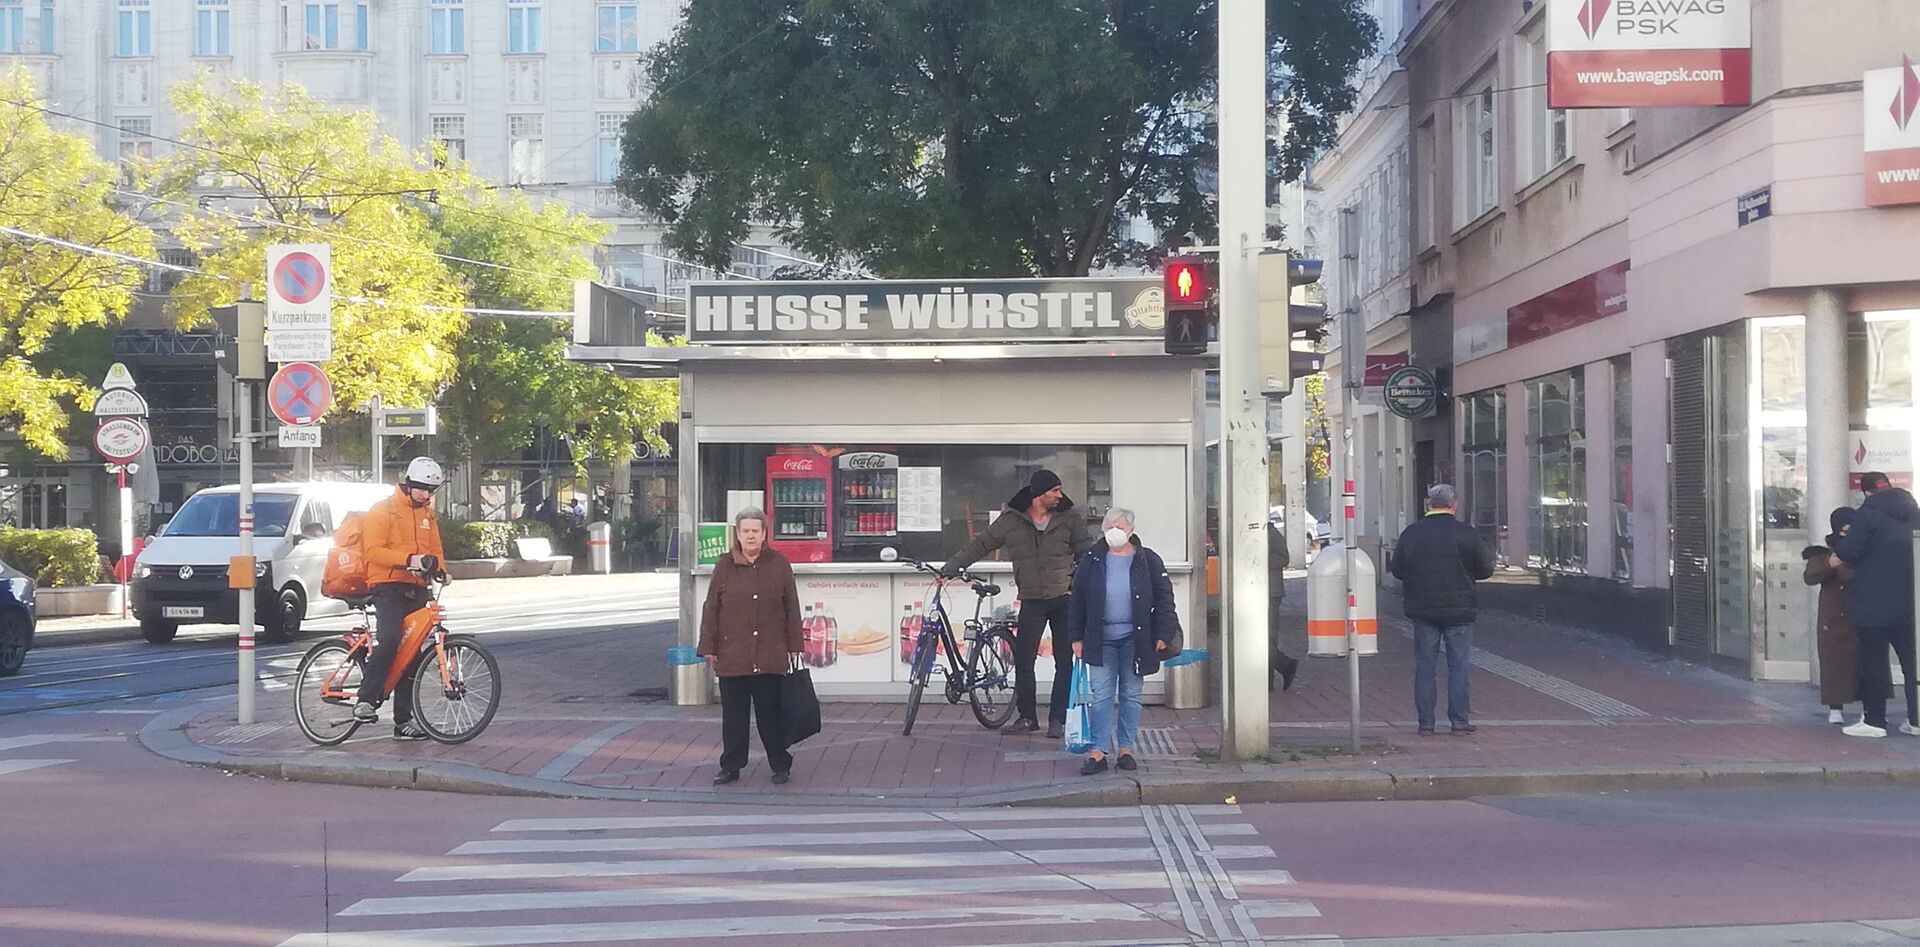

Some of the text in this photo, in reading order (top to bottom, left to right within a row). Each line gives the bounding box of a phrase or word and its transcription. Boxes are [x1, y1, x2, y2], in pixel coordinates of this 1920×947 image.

[1617, 0, 1725, 16] BAWAG
[1617, 19, 1679, 35] PSK
[1577, 67, 1724, 85] www.bawagpsk.com
[695, 286, 1120, 331] HEISSE WÜRSTEL
[1131, 304, 1165, 318] Ottakrin
[271, 310, 327, 326] Kurzparkzone
[105, 392, 135, 402] AUTOBUS
[1390, 387, 1432, 396] Heineken
[101, 422, 141, 436] STRASSENBAHN
[178, 435, 194, 443] DAS
[283, 430, 317, 443] Anfang
[102, 443, 139, 456] HALTESTELLE
[807, 581, 831, 589] Gehört
